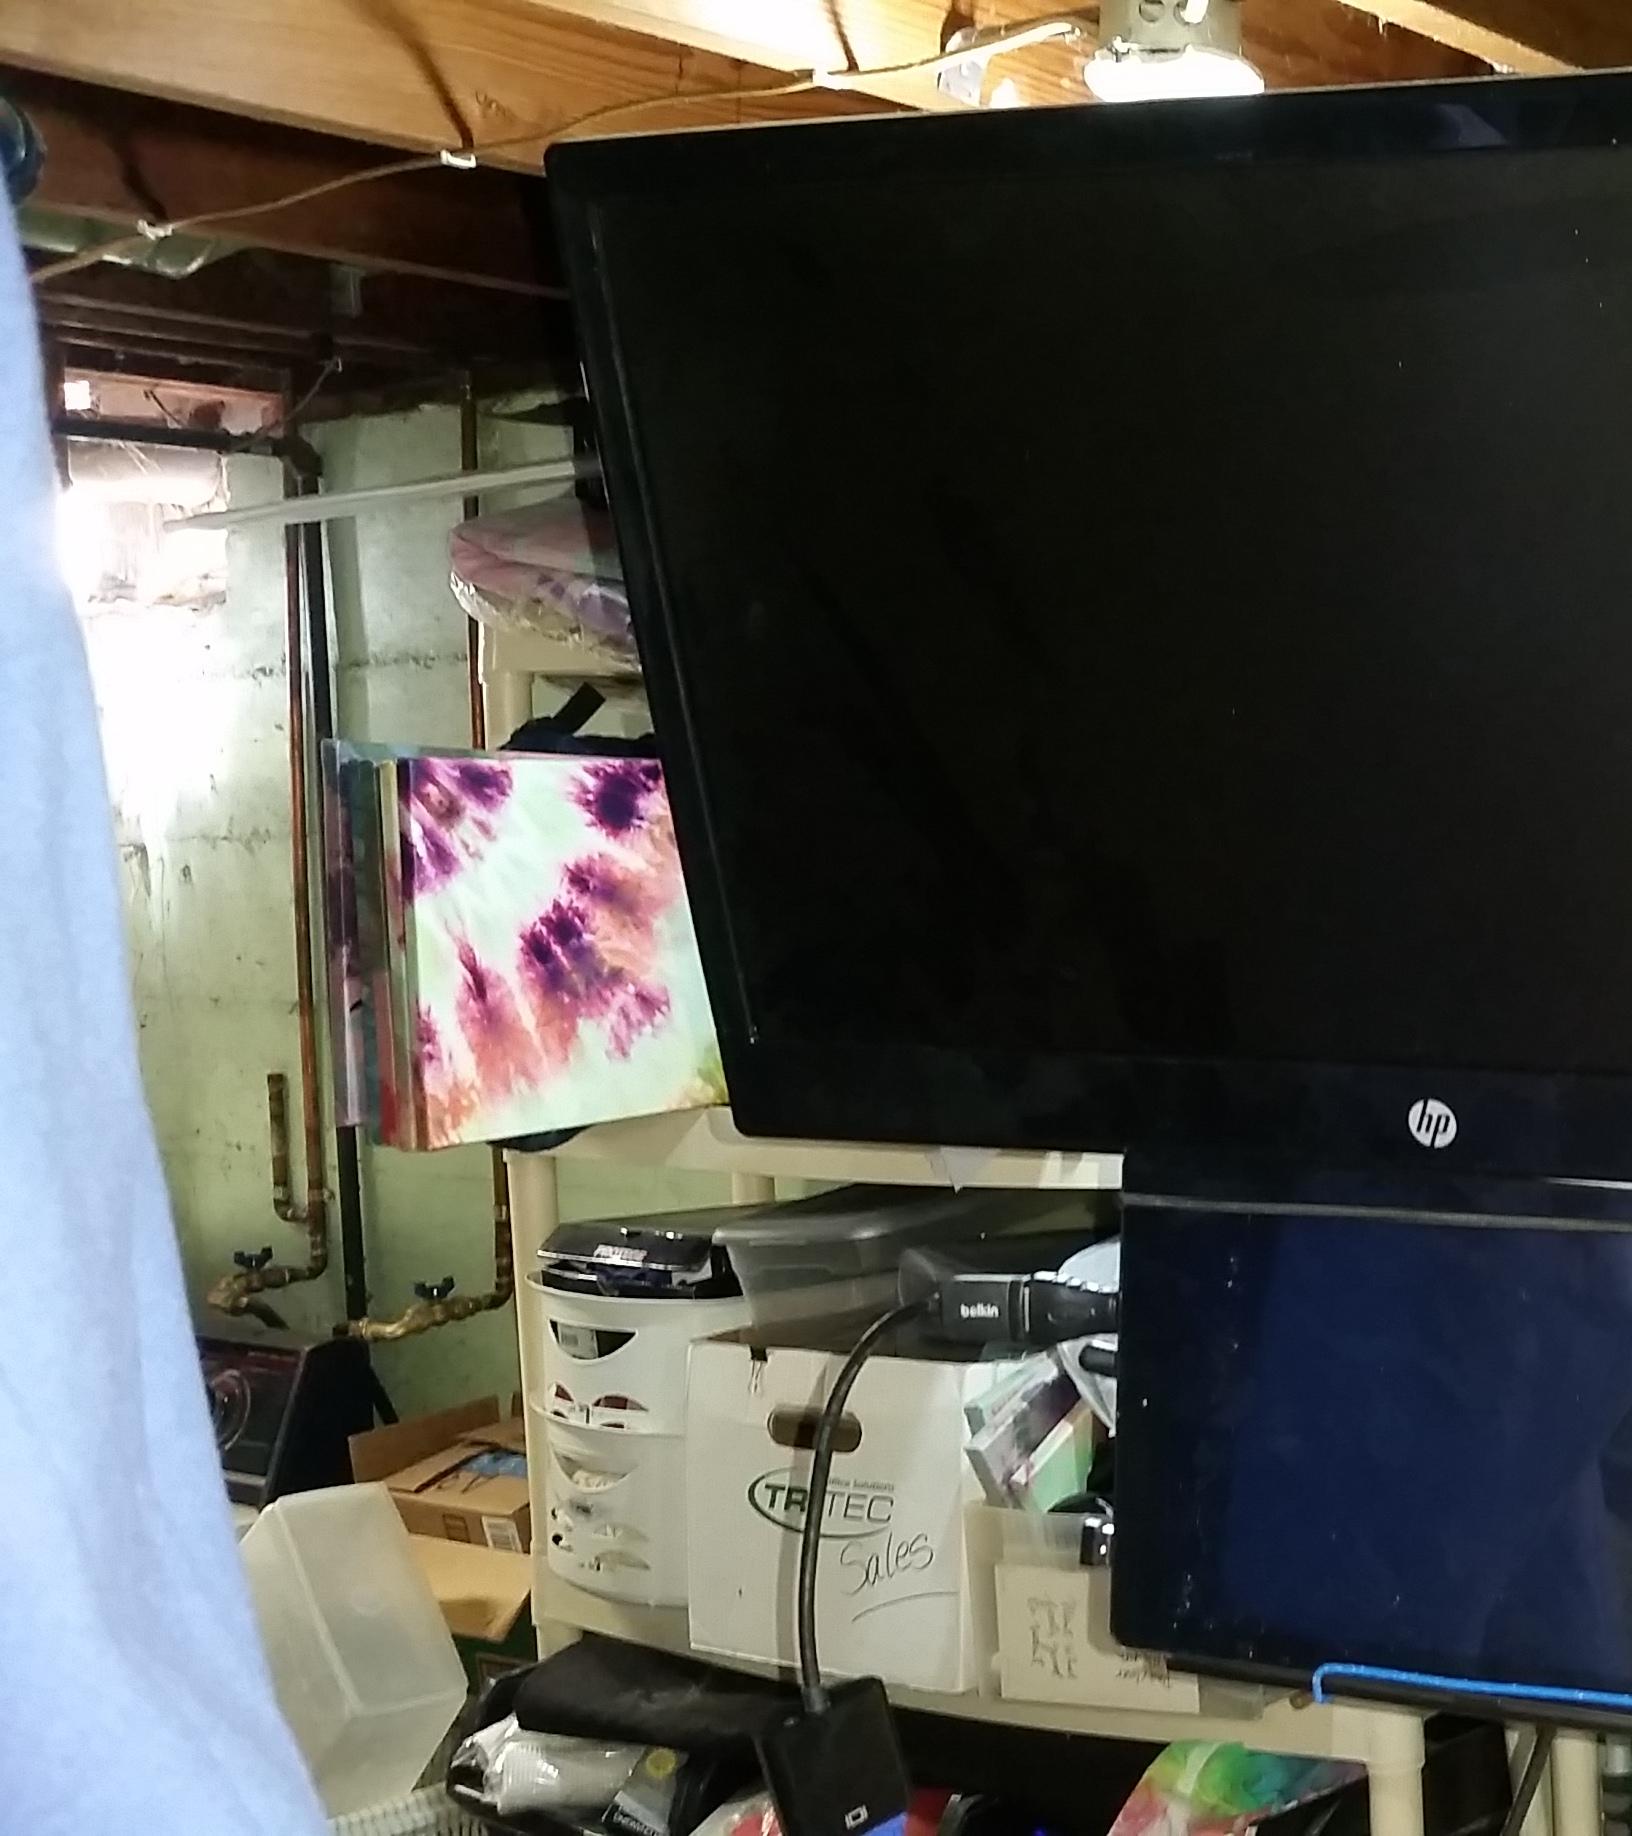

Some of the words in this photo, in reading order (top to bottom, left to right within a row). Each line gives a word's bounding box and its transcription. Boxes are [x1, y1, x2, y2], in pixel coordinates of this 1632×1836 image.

[1411, 1098, 1454, 1149] hp
[959, 1302, 999, 1319] belkin
[764, 1482, 895, 1524] TRTEC
[840, 1532, 934, 1596] Sales
